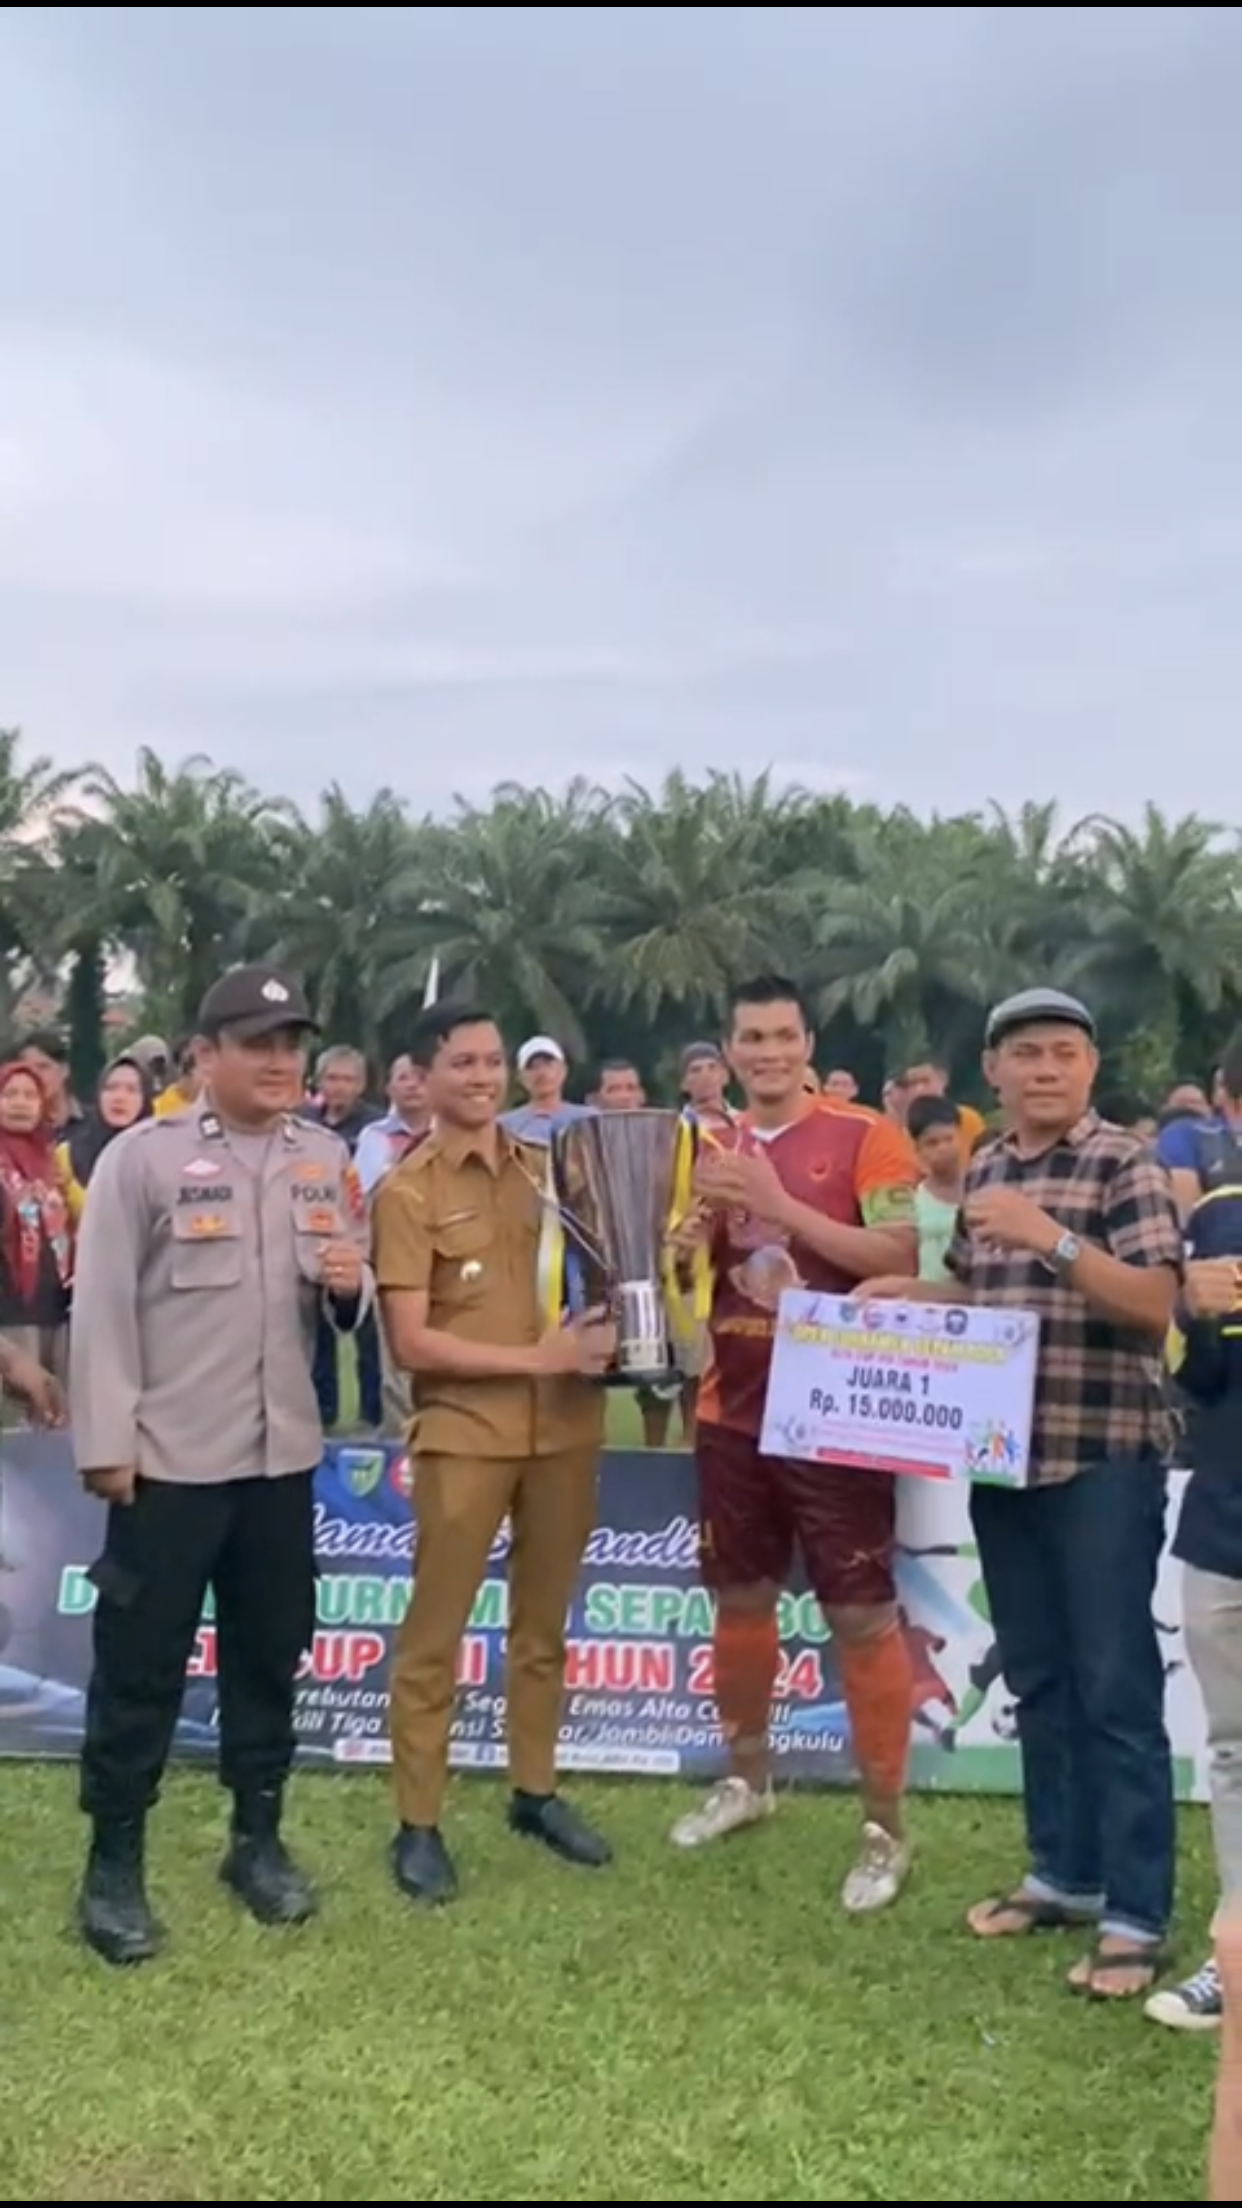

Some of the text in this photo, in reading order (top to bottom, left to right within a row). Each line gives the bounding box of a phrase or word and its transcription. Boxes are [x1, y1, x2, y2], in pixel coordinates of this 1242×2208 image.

[846, 1366, 930, 1396] JUARA 1
[809, 1388, 963, 1430] Rp. 15.000.000
[585, 1583, 717, 1635] SEPA
[294, 1629, 385, 1682] UP
[569, 1696, 634, 1716] Emas
[639, 1698, 686, 1720] Alta
[330, 1712, 382, 1736] Tiga
[768, 1733, 844, 1753] ngkulu
